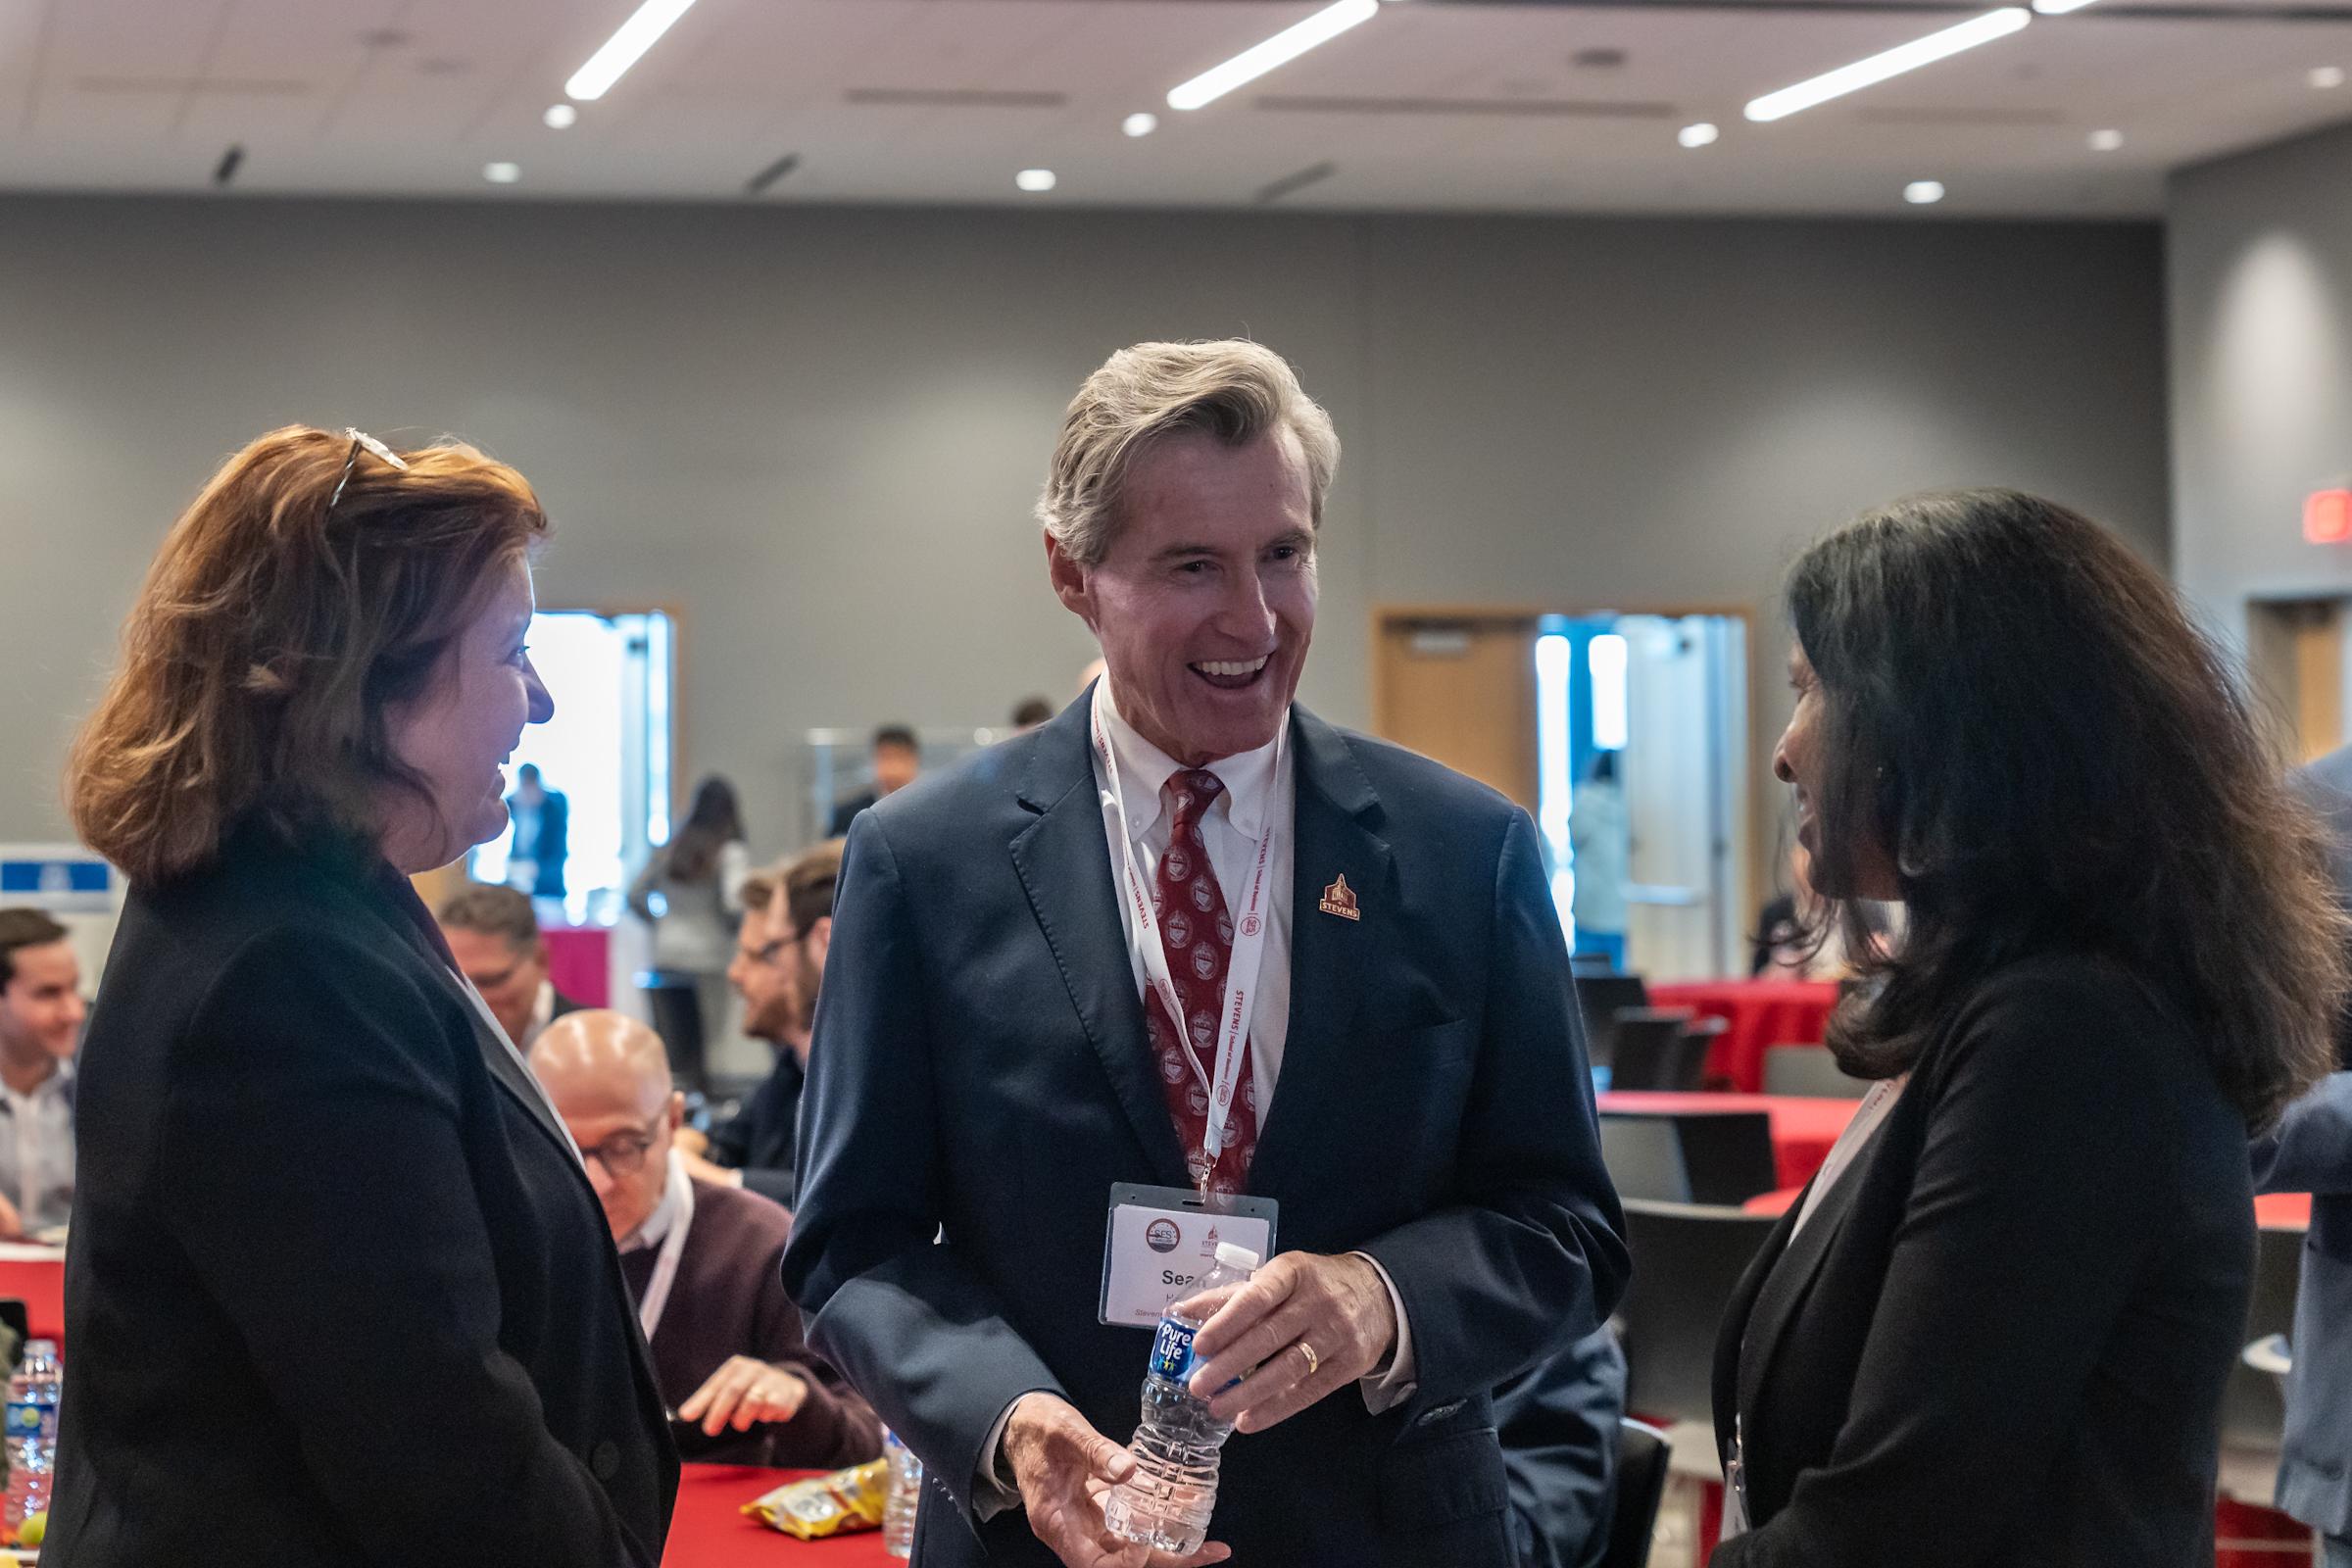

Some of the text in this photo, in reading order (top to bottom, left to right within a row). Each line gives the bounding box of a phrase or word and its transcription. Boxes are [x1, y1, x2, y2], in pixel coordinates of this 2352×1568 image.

[1135, 891, 1149, 929] STEVENS
[1322, 903, 1357, 917] STEVENS
[1231, 989, 1244, 1033] STEVENS
[1161, 1324, 1191, 1347] Pure
[1159, 1339, 1182, 1360] Life
